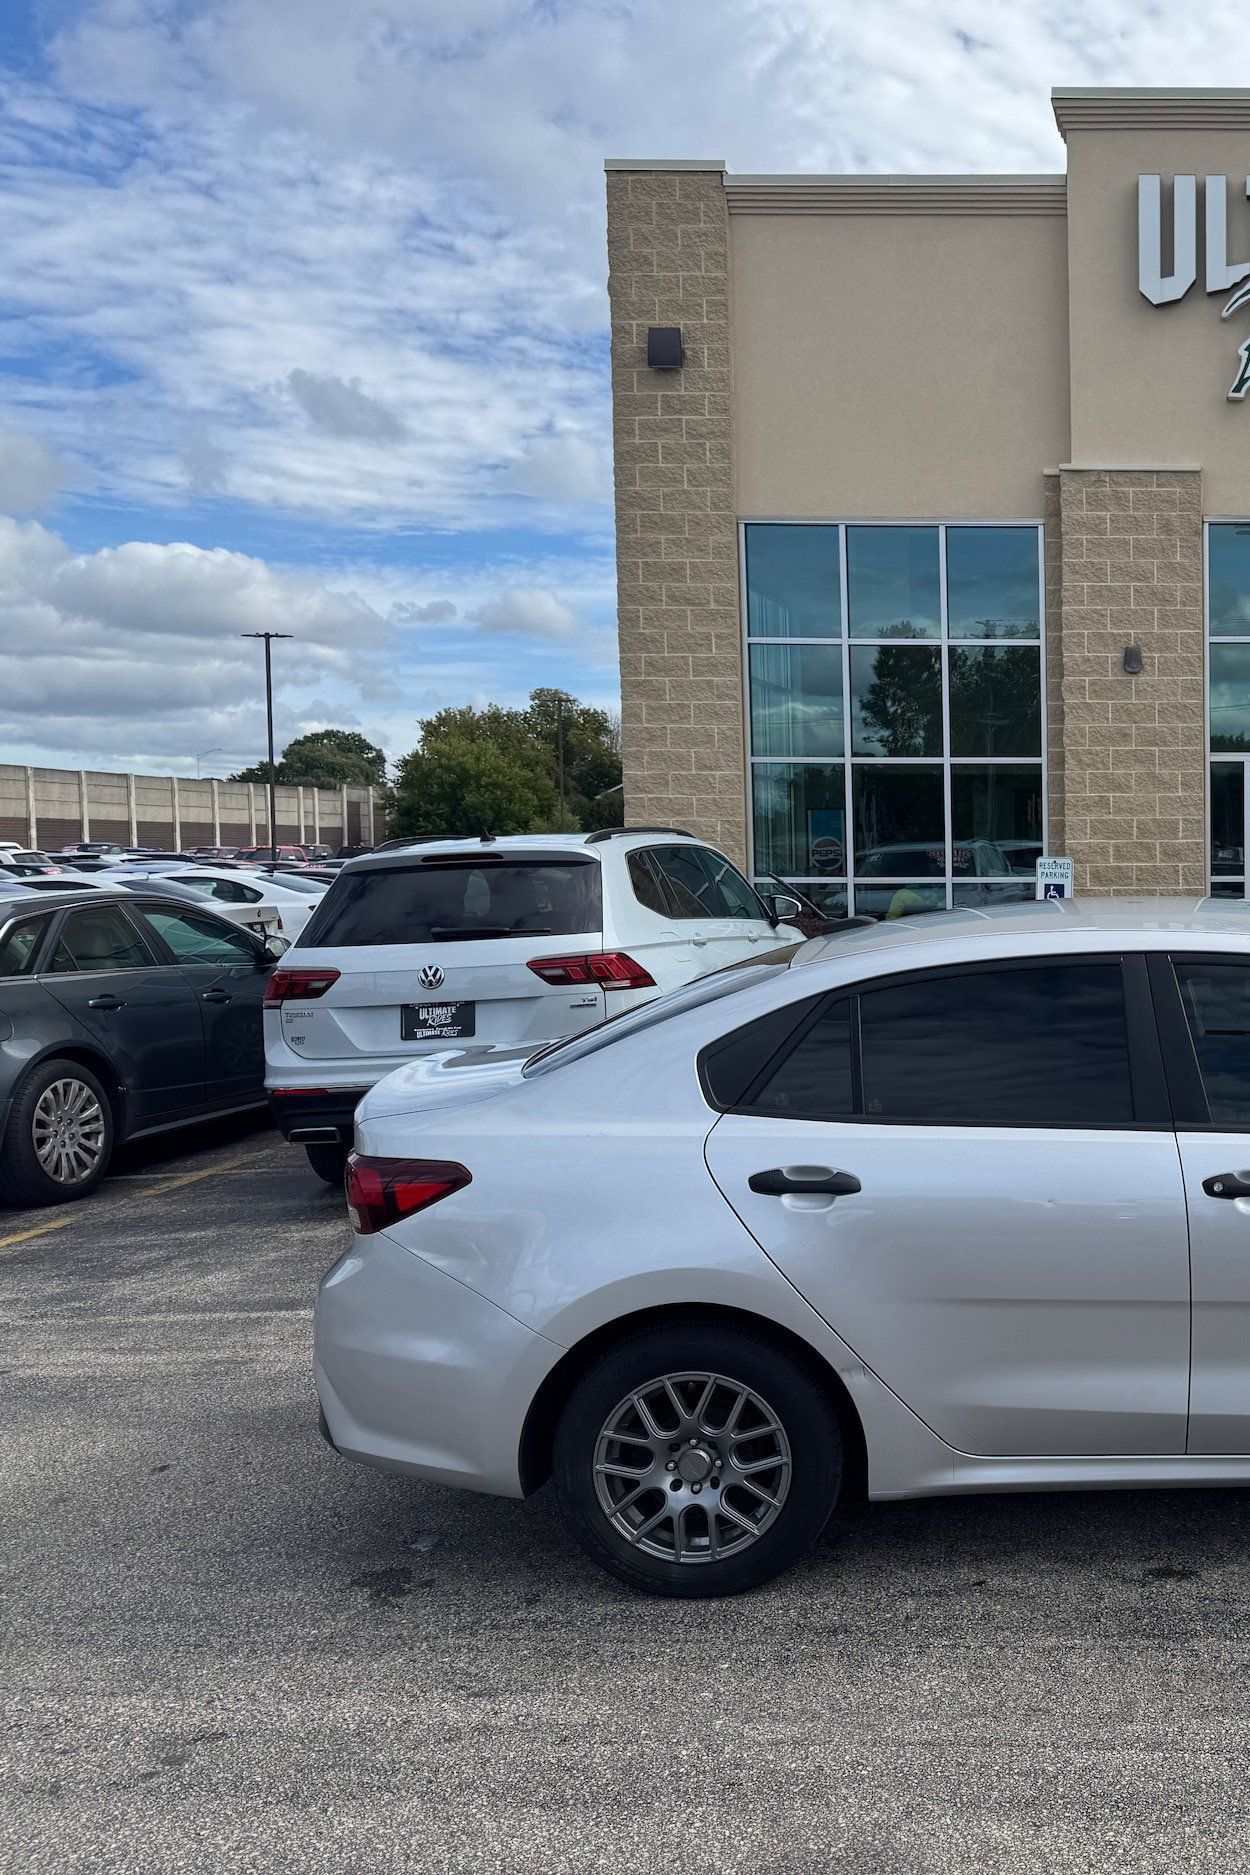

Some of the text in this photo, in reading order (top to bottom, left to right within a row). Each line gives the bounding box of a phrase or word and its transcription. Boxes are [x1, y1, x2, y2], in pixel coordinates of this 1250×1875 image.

[1040, 862, 1071, 870] RESERVED
[1041, 871, 1069, 879] PARKING
[419, 1006, 457, 1020] ULTIMATE
